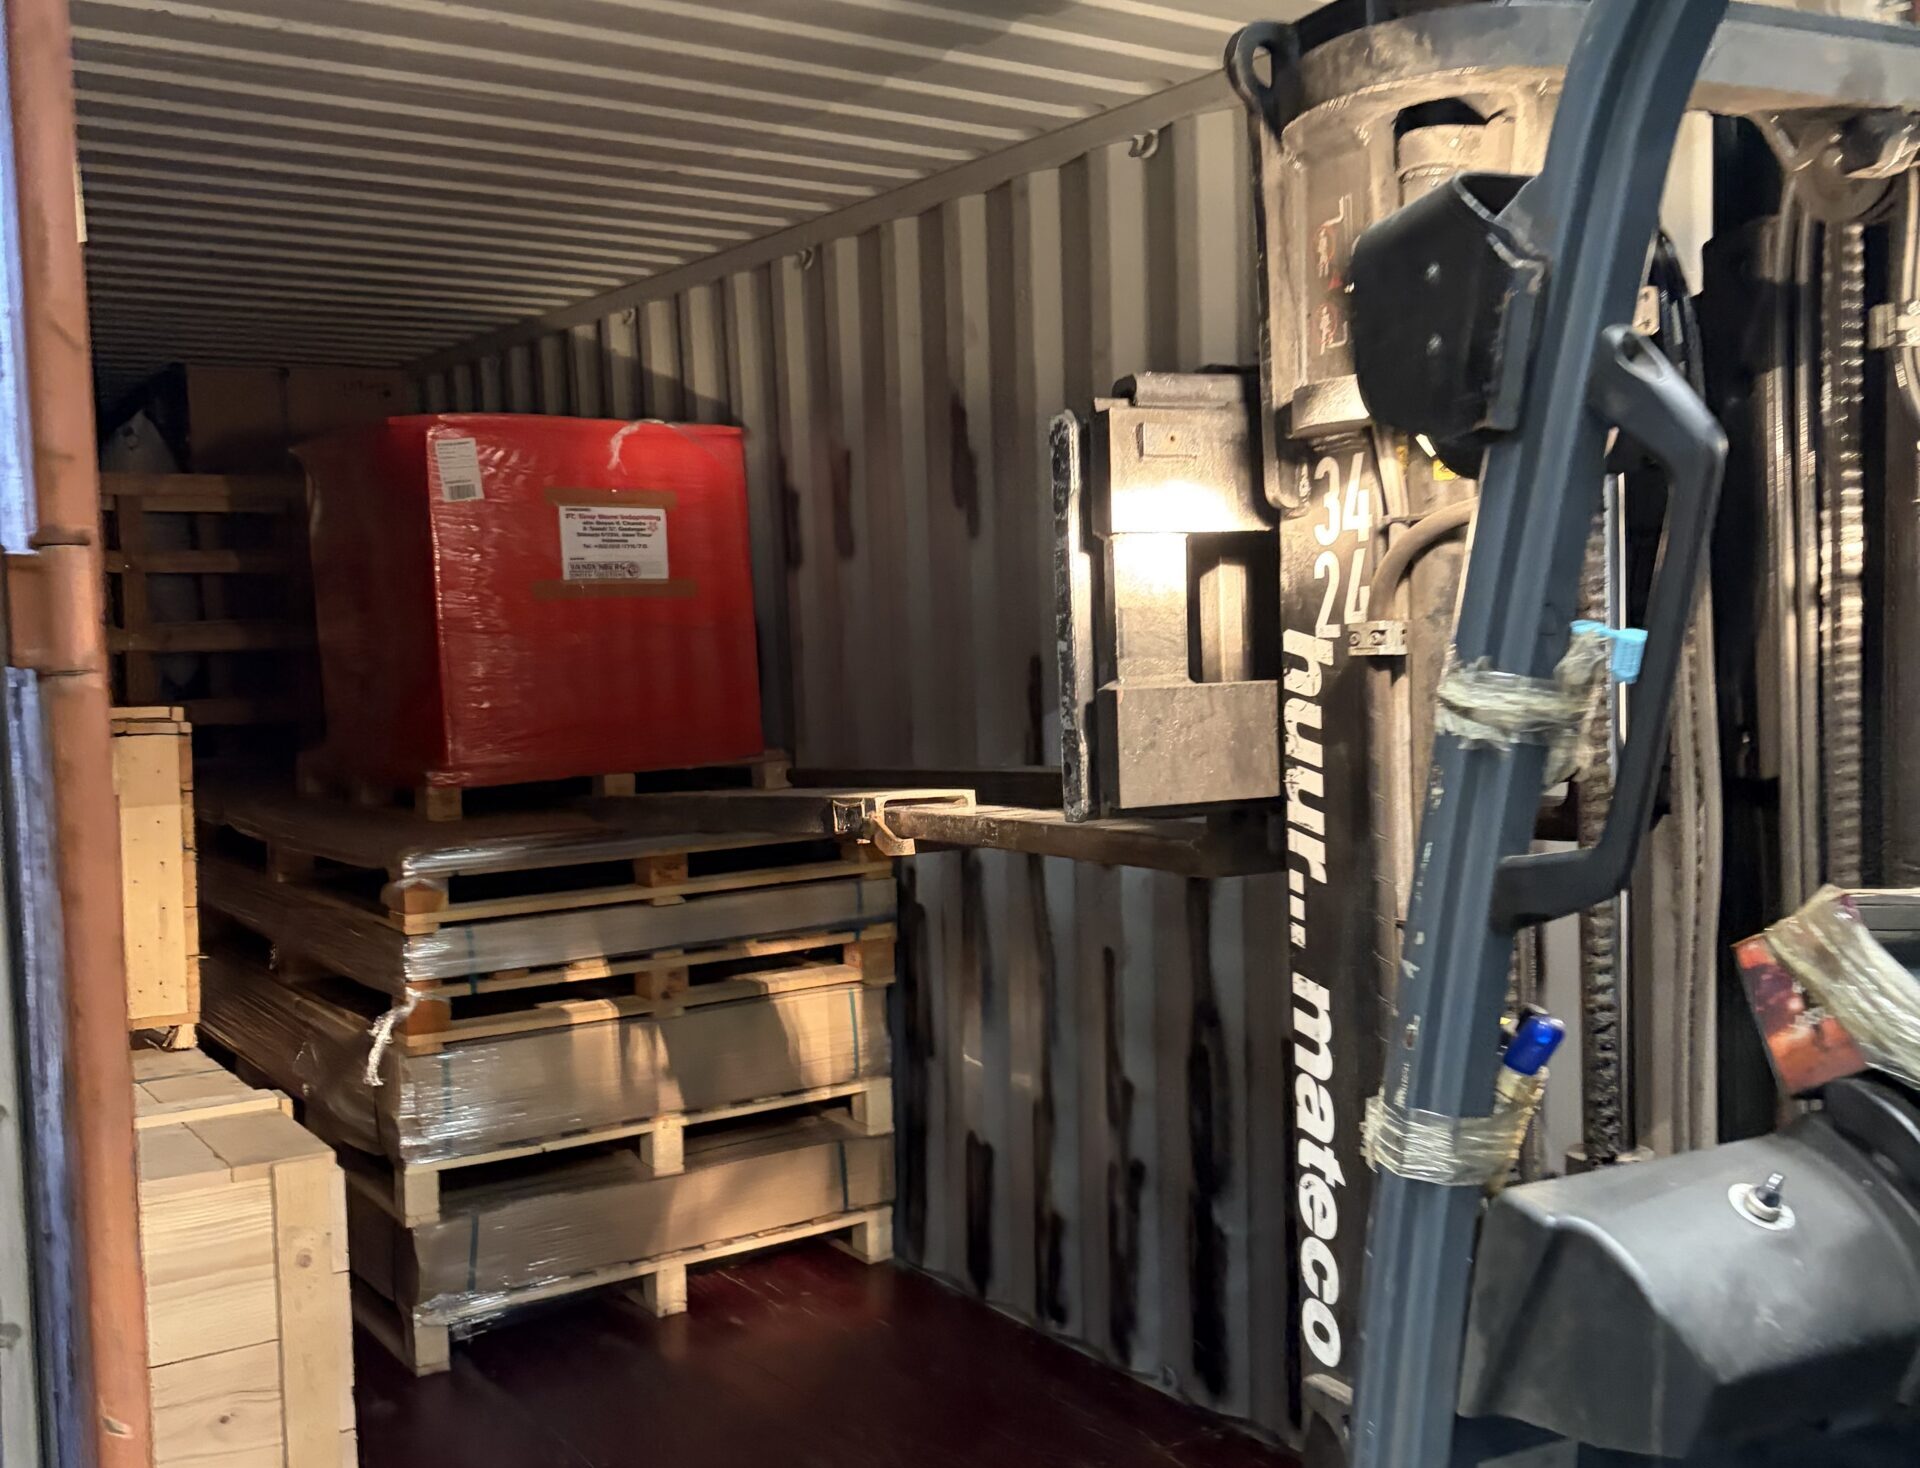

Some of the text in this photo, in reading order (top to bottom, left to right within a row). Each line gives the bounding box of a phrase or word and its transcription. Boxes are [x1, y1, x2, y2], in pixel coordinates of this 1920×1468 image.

[1314, 452, 1373, 546] 34
[1314, 548, 1371, 639] 24
[1290, 971, 1346, 1368] mateco
